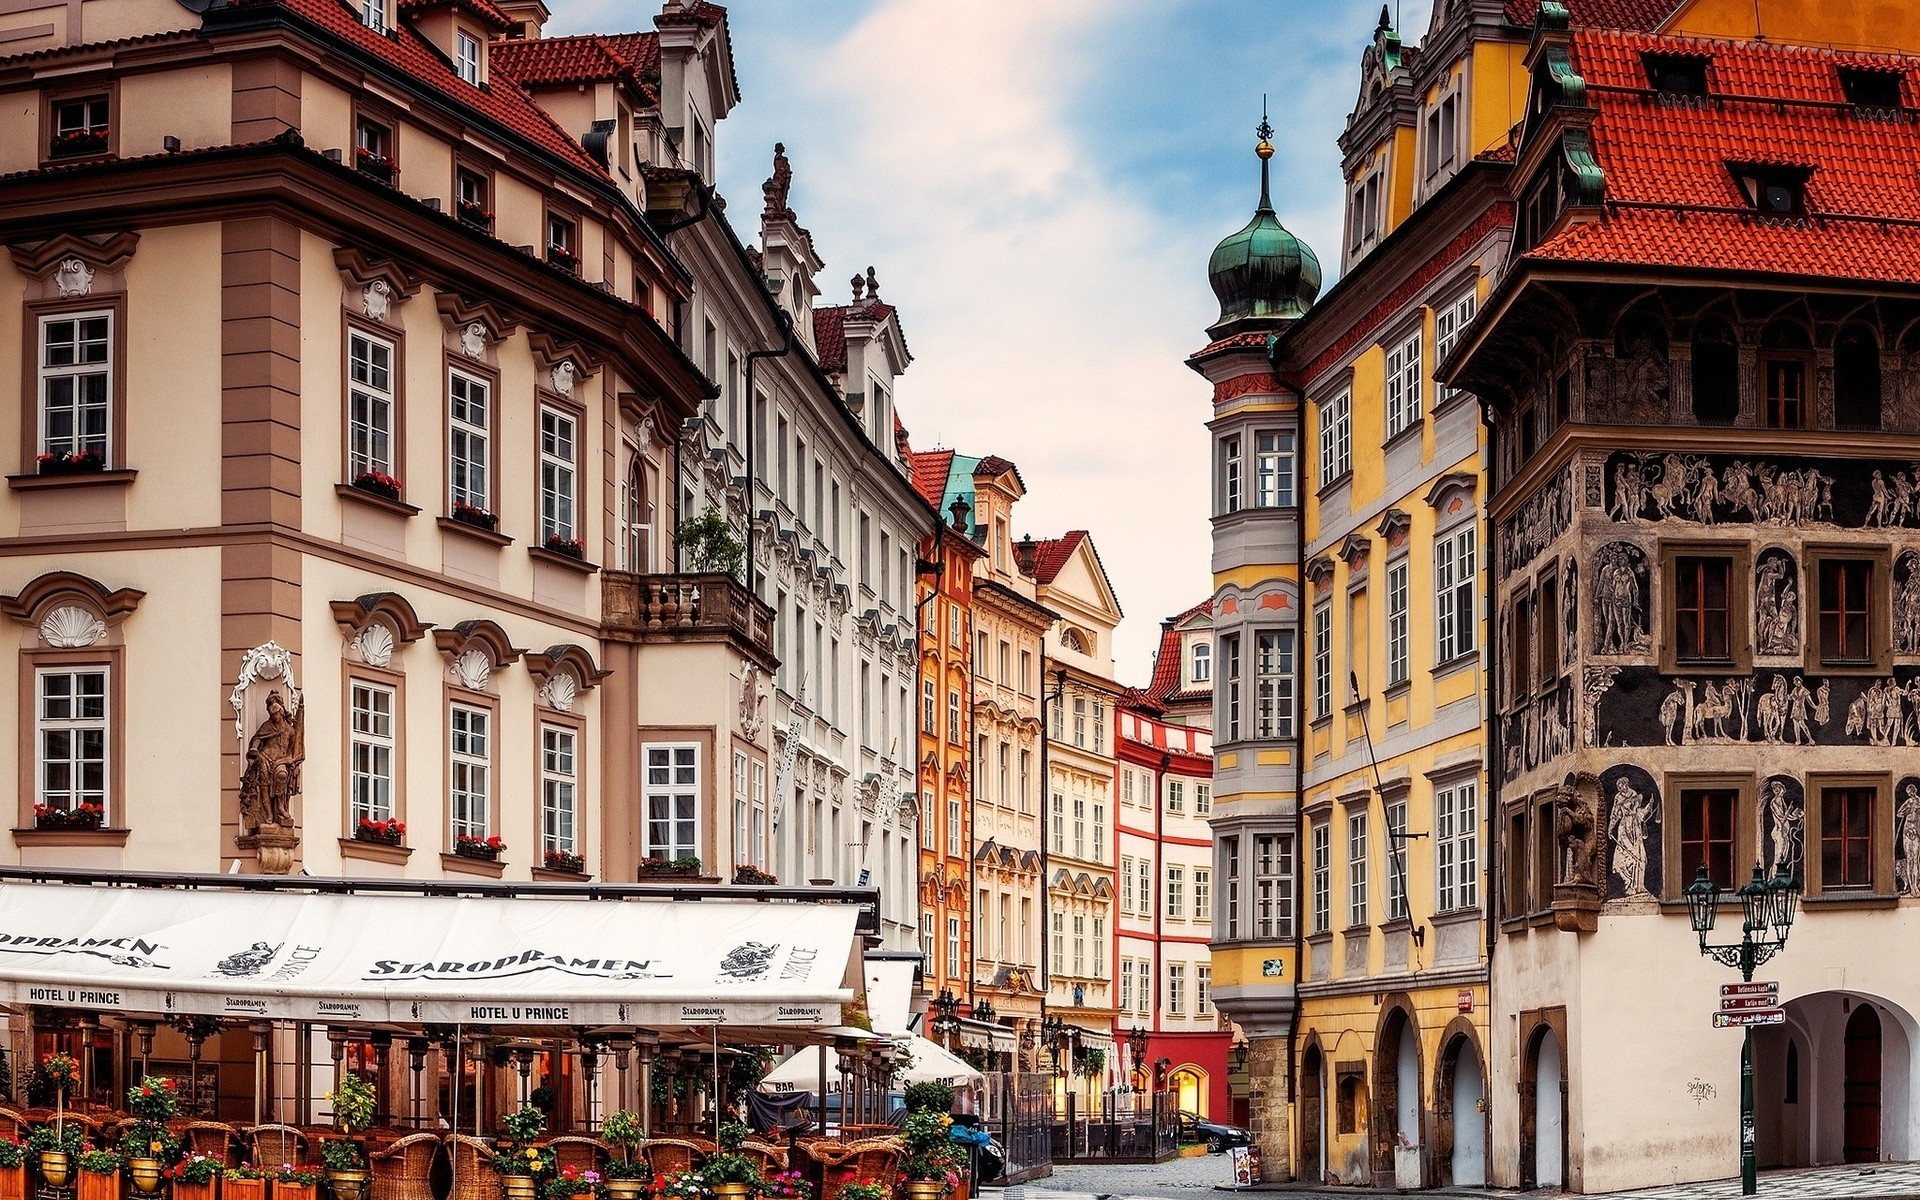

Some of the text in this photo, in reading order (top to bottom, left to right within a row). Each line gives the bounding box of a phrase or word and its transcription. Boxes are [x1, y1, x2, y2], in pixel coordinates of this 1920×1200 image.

[369, 949, 650, 975] STAROPRAMEN
[30, 988, 120, 1005] HOTEL U PRINCE
[225, 997, 267, 1007] STAROPRAMEN
[318, 1001, 360, 1011] STAROPRAMEN
[471, 1006, 569, 1020] HOTEL U PRINCE
[681, 1006, 725, 1016] STAROPRAMEN
[778, 1006, 821, 1016] STAROPRAMEN
[775, 1082, 795, 1092] BAR
[935, 1077, 954, 1088] BAR
